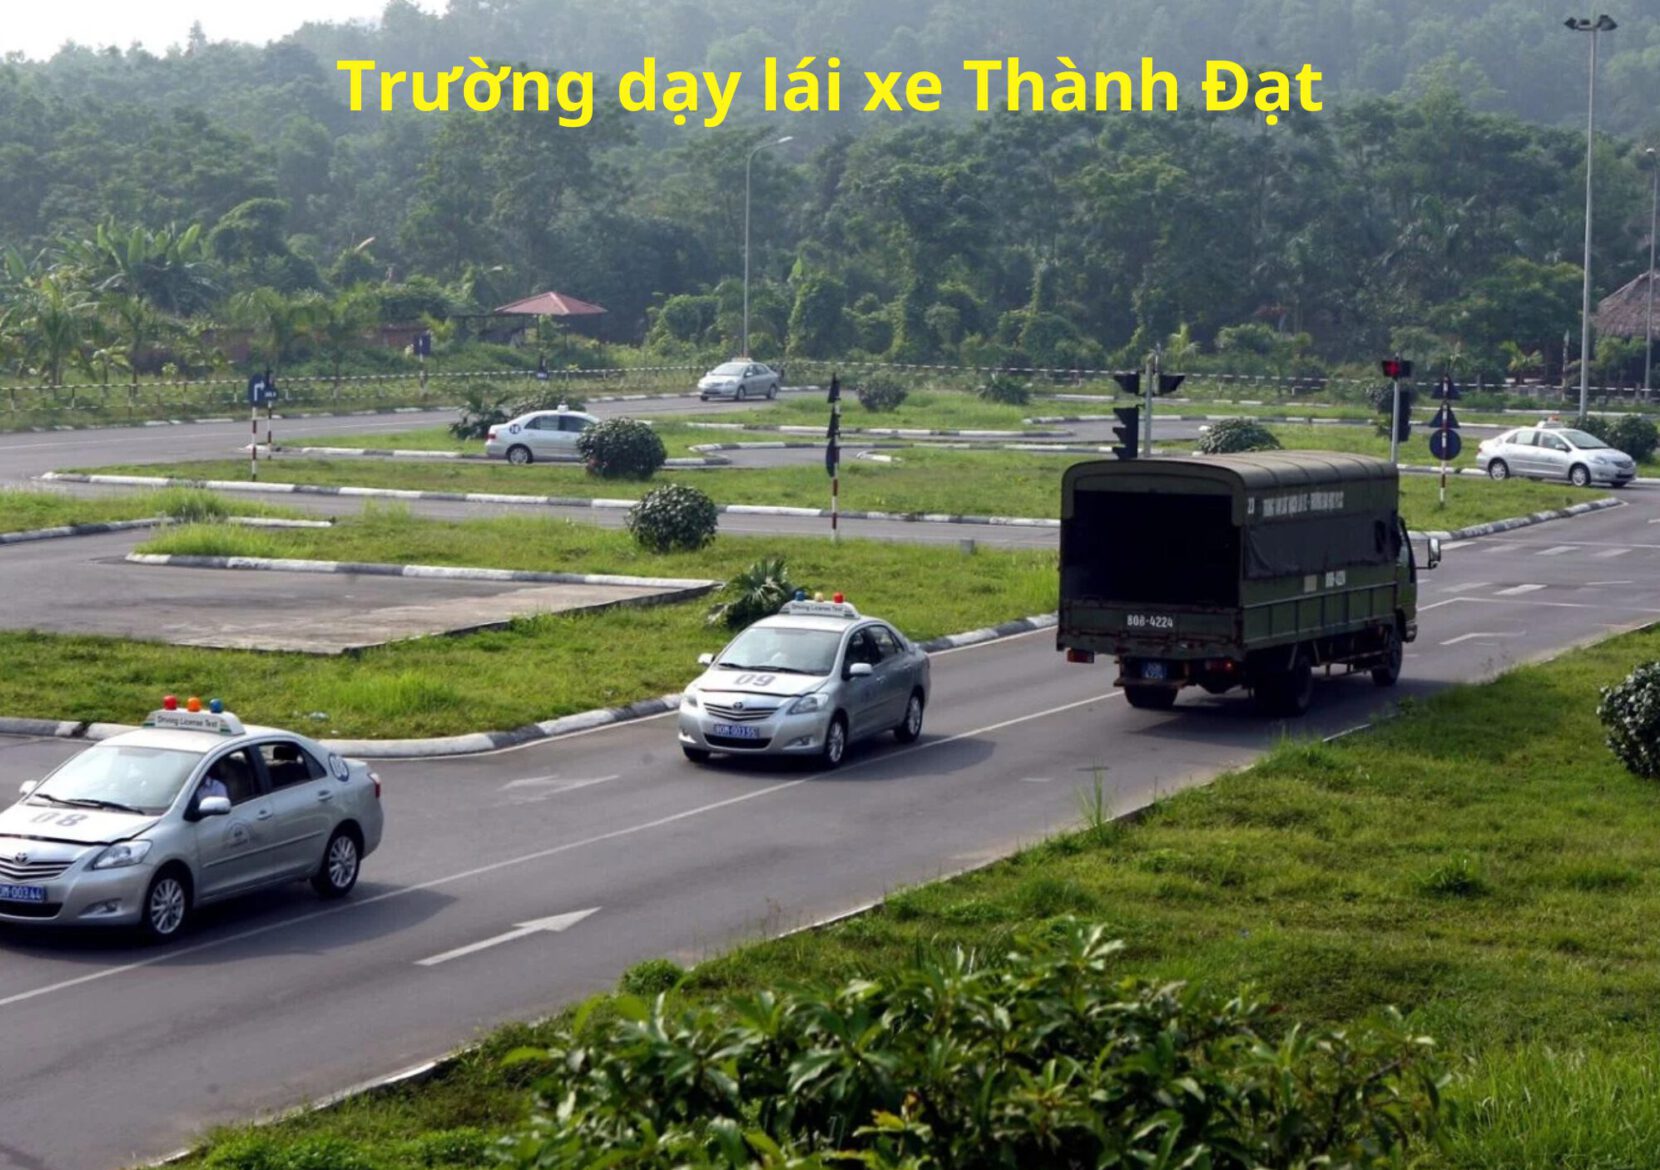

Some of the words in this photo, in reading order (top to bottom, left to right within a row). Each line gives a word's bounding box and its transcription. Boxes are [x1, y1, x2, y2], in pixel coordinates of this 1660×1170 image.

[733, 673, 777, 687] 09
[157, 715, 179, 726] Driving
[180, 716, 204, 728] License
[204, 718, 218, 729] Test
[29, 811, 89, 827] 08
